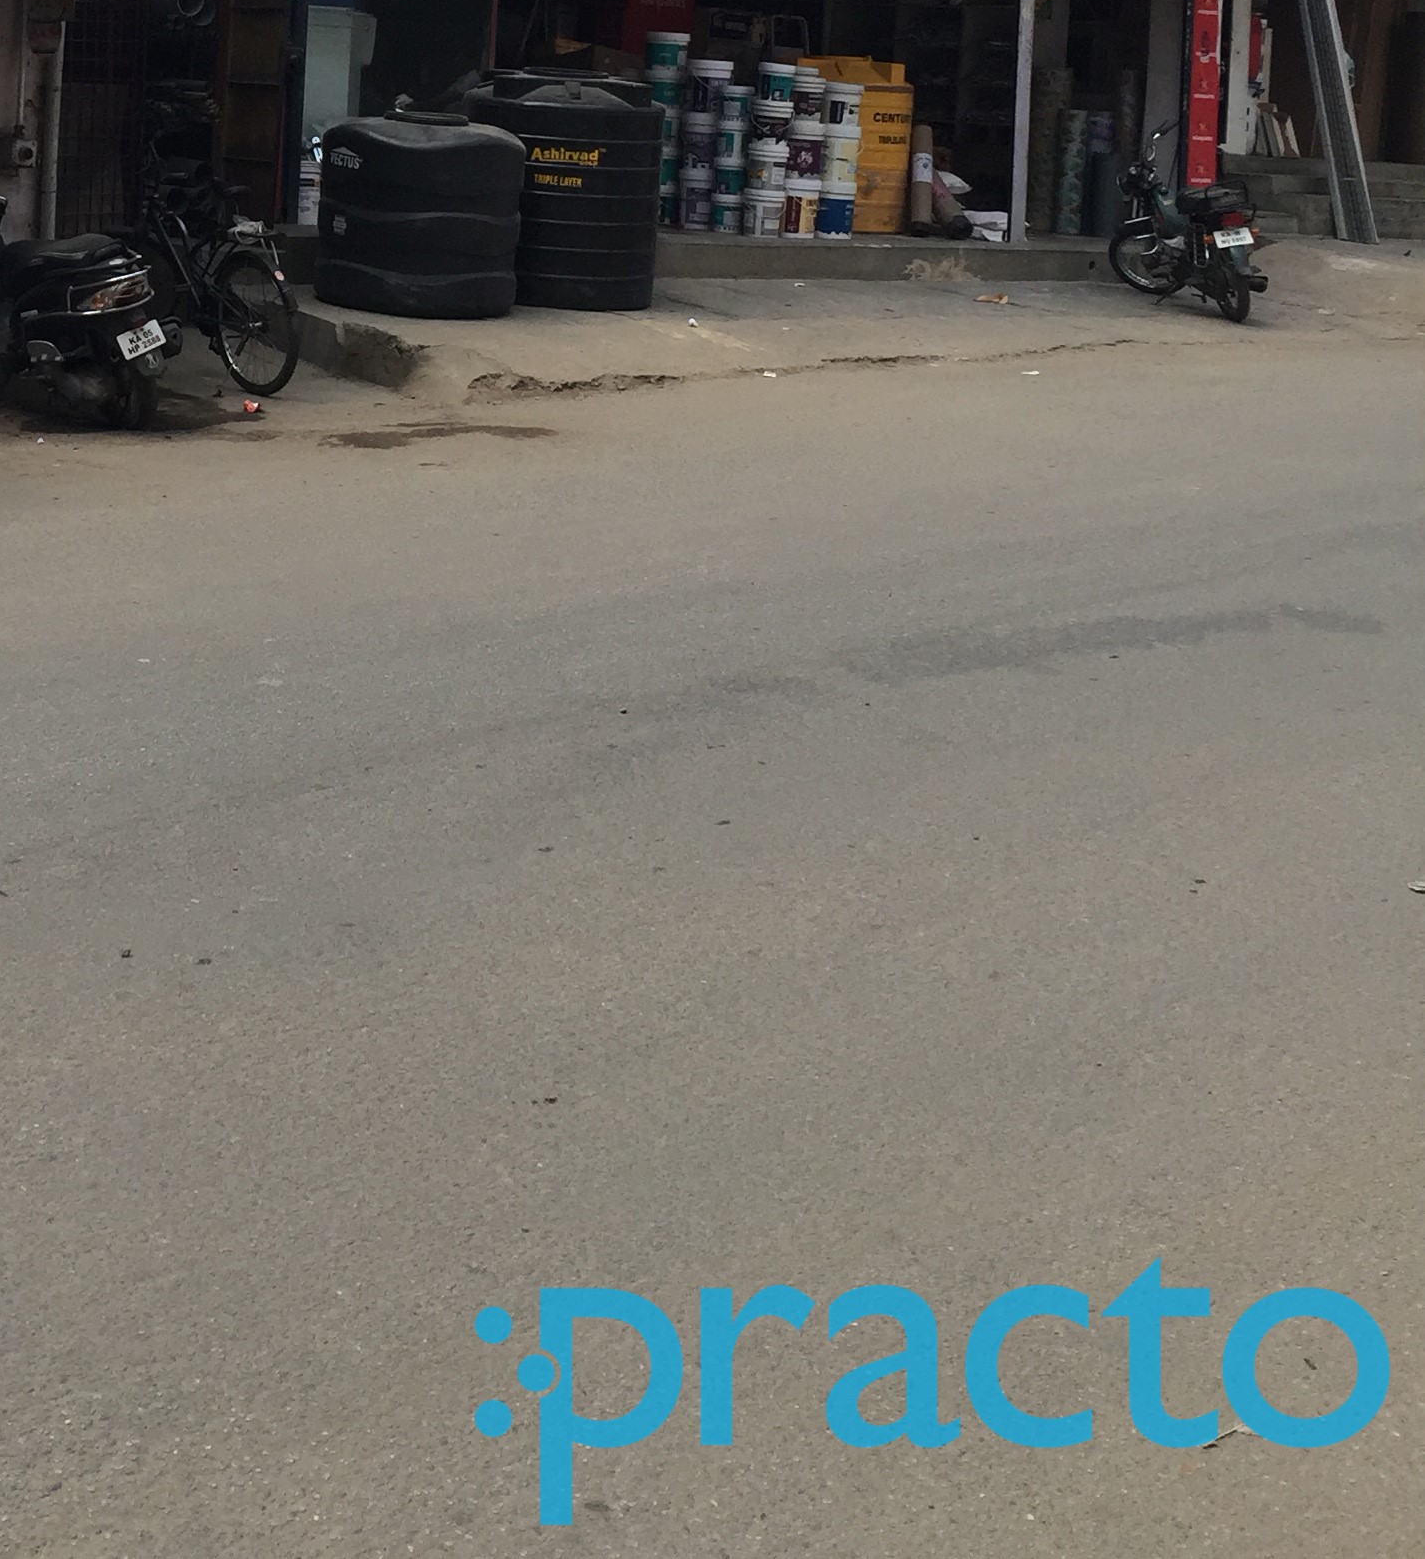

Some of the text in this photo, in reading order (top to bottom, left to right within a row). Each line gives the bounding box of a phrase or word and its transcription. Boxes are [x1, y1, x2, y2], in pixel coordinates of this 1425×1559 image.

[330, 150, 361, 170] VECTUS
[530, 147, 600, 162] Ashirvad
[534, 173, 583, 188] TRIPLE LAYER
[128, 334, 142, 345] KA
